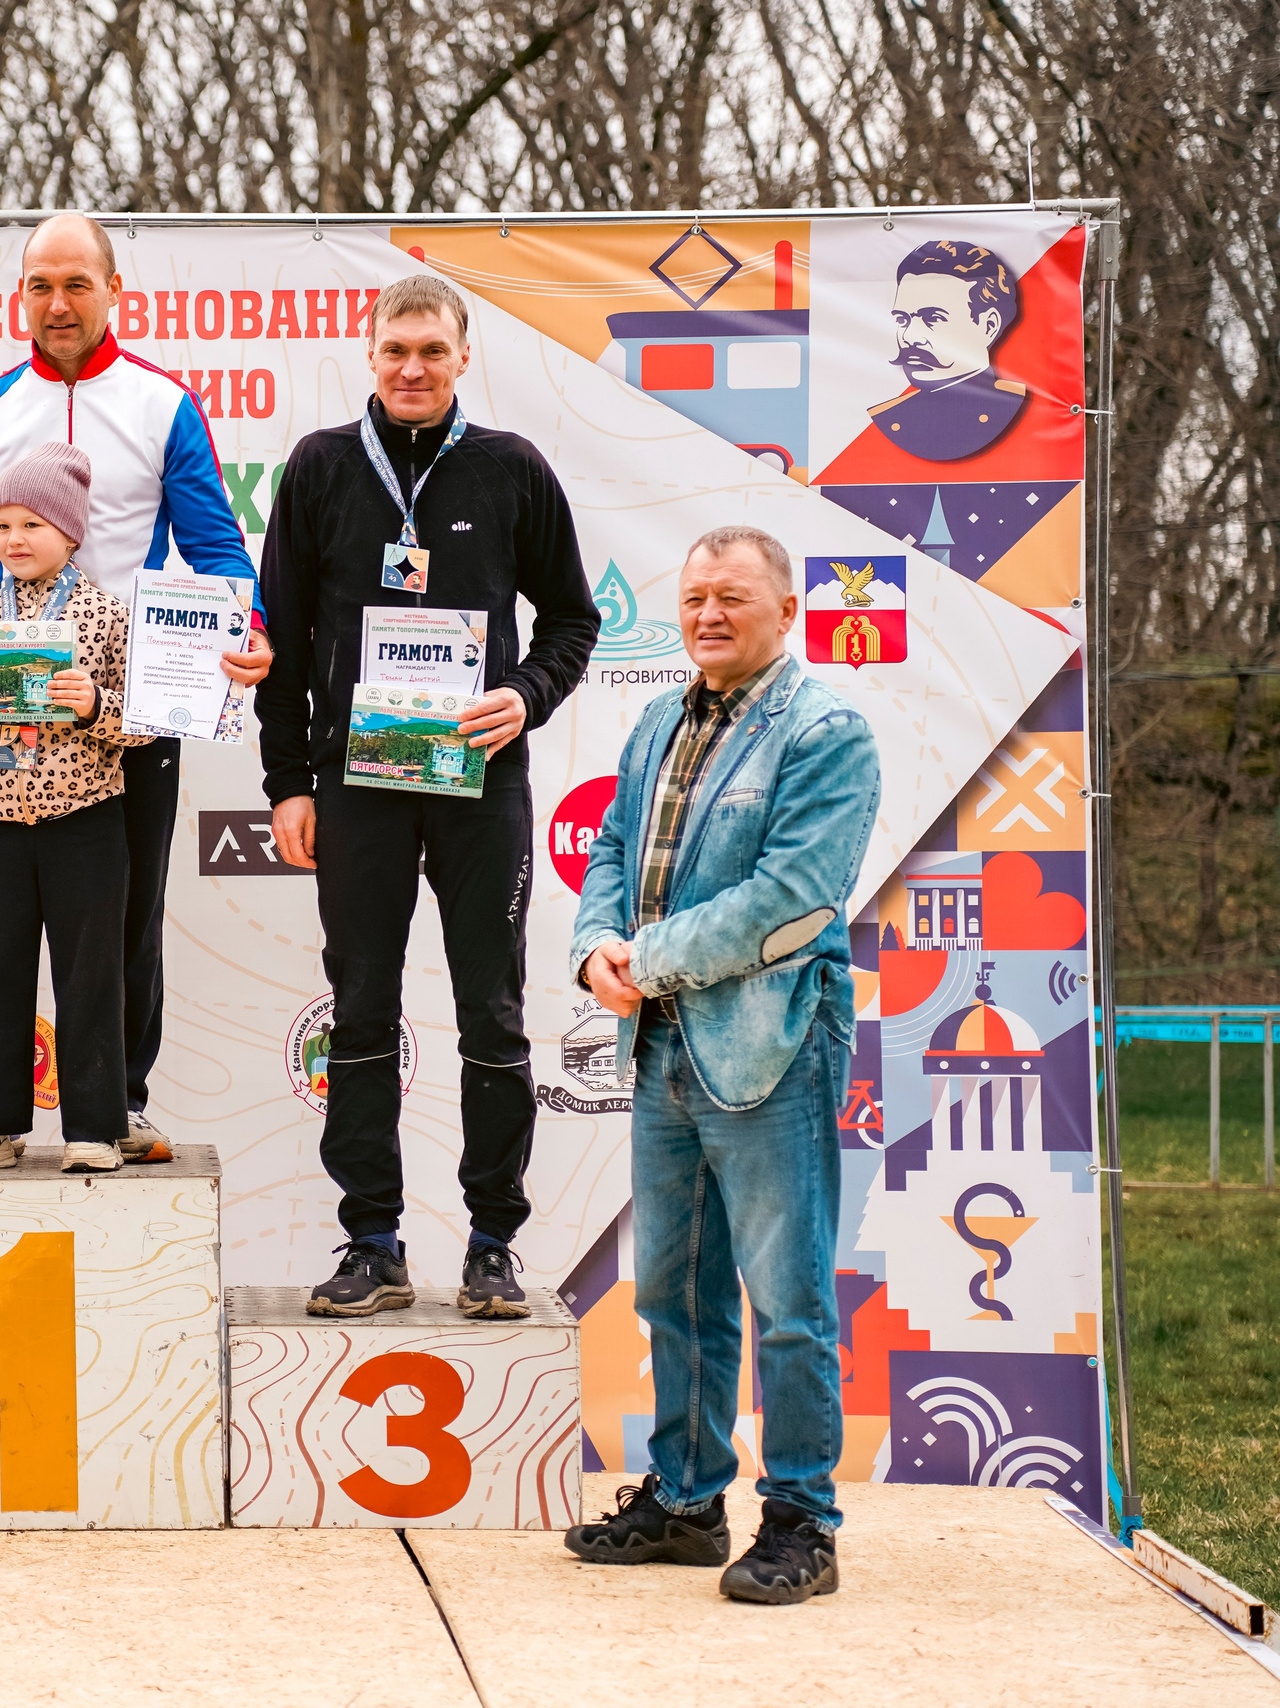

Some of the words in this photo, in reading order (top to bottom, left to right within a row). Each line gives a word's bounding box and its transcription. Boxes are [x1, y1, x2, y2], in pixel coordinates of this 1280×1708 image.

[140, 589, 163, 597] ПАМЯТИ
[165, 591, 196, 600] ТОПОГРАФА
[197, 594, 229, 602] ПАСТУХОВА
[145, 606, 218, 631] ГРАМОТА
[378, 643, 453, 662] ГРАМОТА
[349, 761, 405, 776] ПЯТИГОРСК
[293, 1016, 312, 1072] Канатная
[338, 1351, 471, 1517] 3
